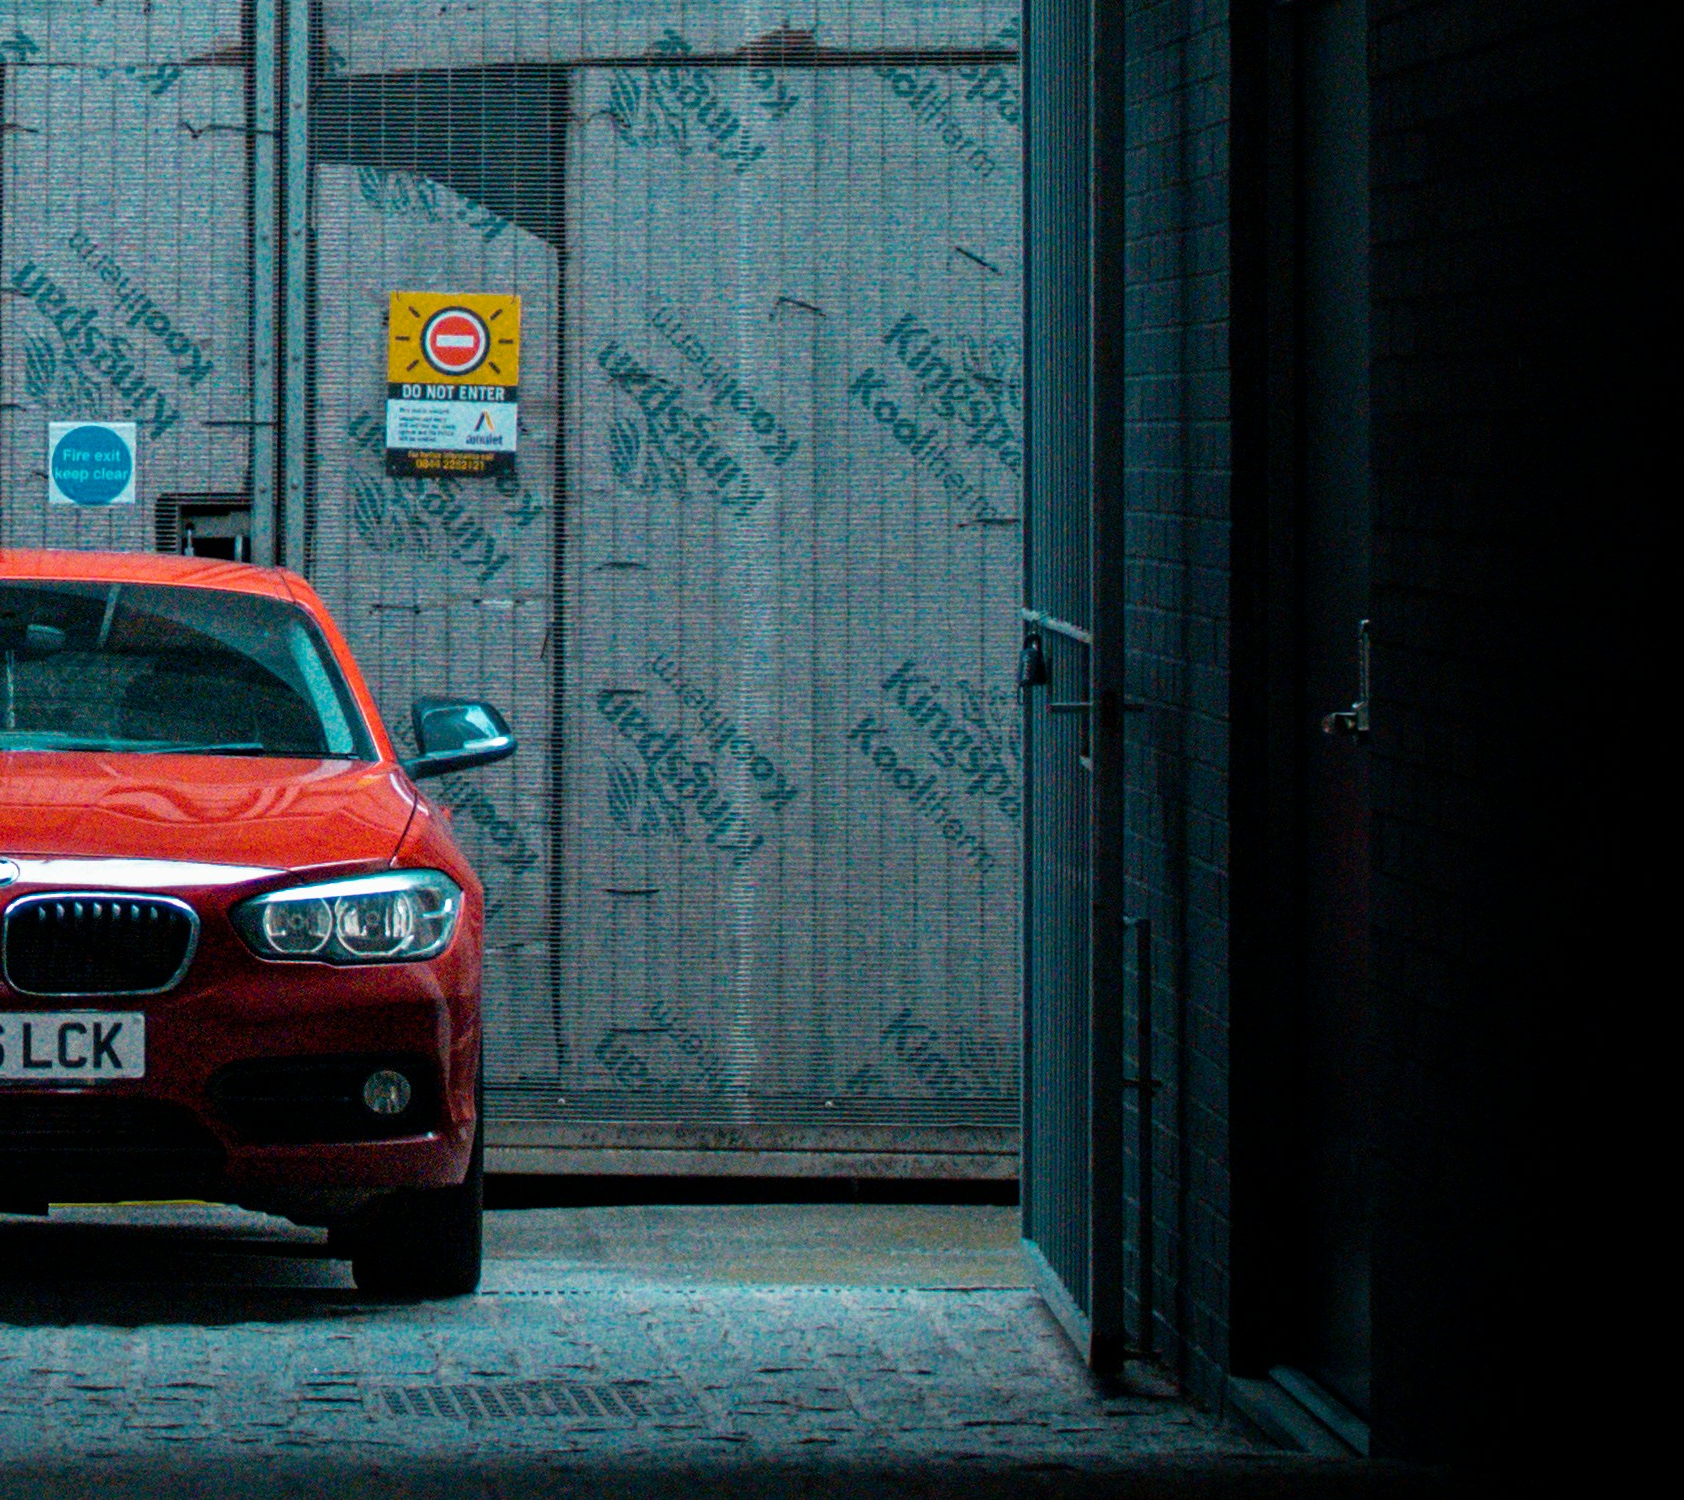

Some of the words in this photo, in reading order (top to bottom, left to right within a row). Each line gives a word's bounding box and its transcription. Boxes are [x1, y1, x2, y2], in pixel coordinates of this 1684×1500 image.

[13, 260, 181, 440] Kingspan
[68, 229, 214, 388] Kooltherm
[652, 307, 800, 467] Kooltherm
[63, 448, 90, 462] Fire
[94, 450, 120, 462] exit
[402, 384, 421, 398] DO
[426, 385, 455, 399] NOT
[459, 386, 505, 401] ENTER
[597, 340, 765, 518] Kingspan
[55, 466, 88, 482] keep
[93, 468, 128, 480] clear
[597, 690, 764, 867] Kingspan
[848, 716, 997, 874] Kooltherm
[22, 1022, 123, 1069] LCK
